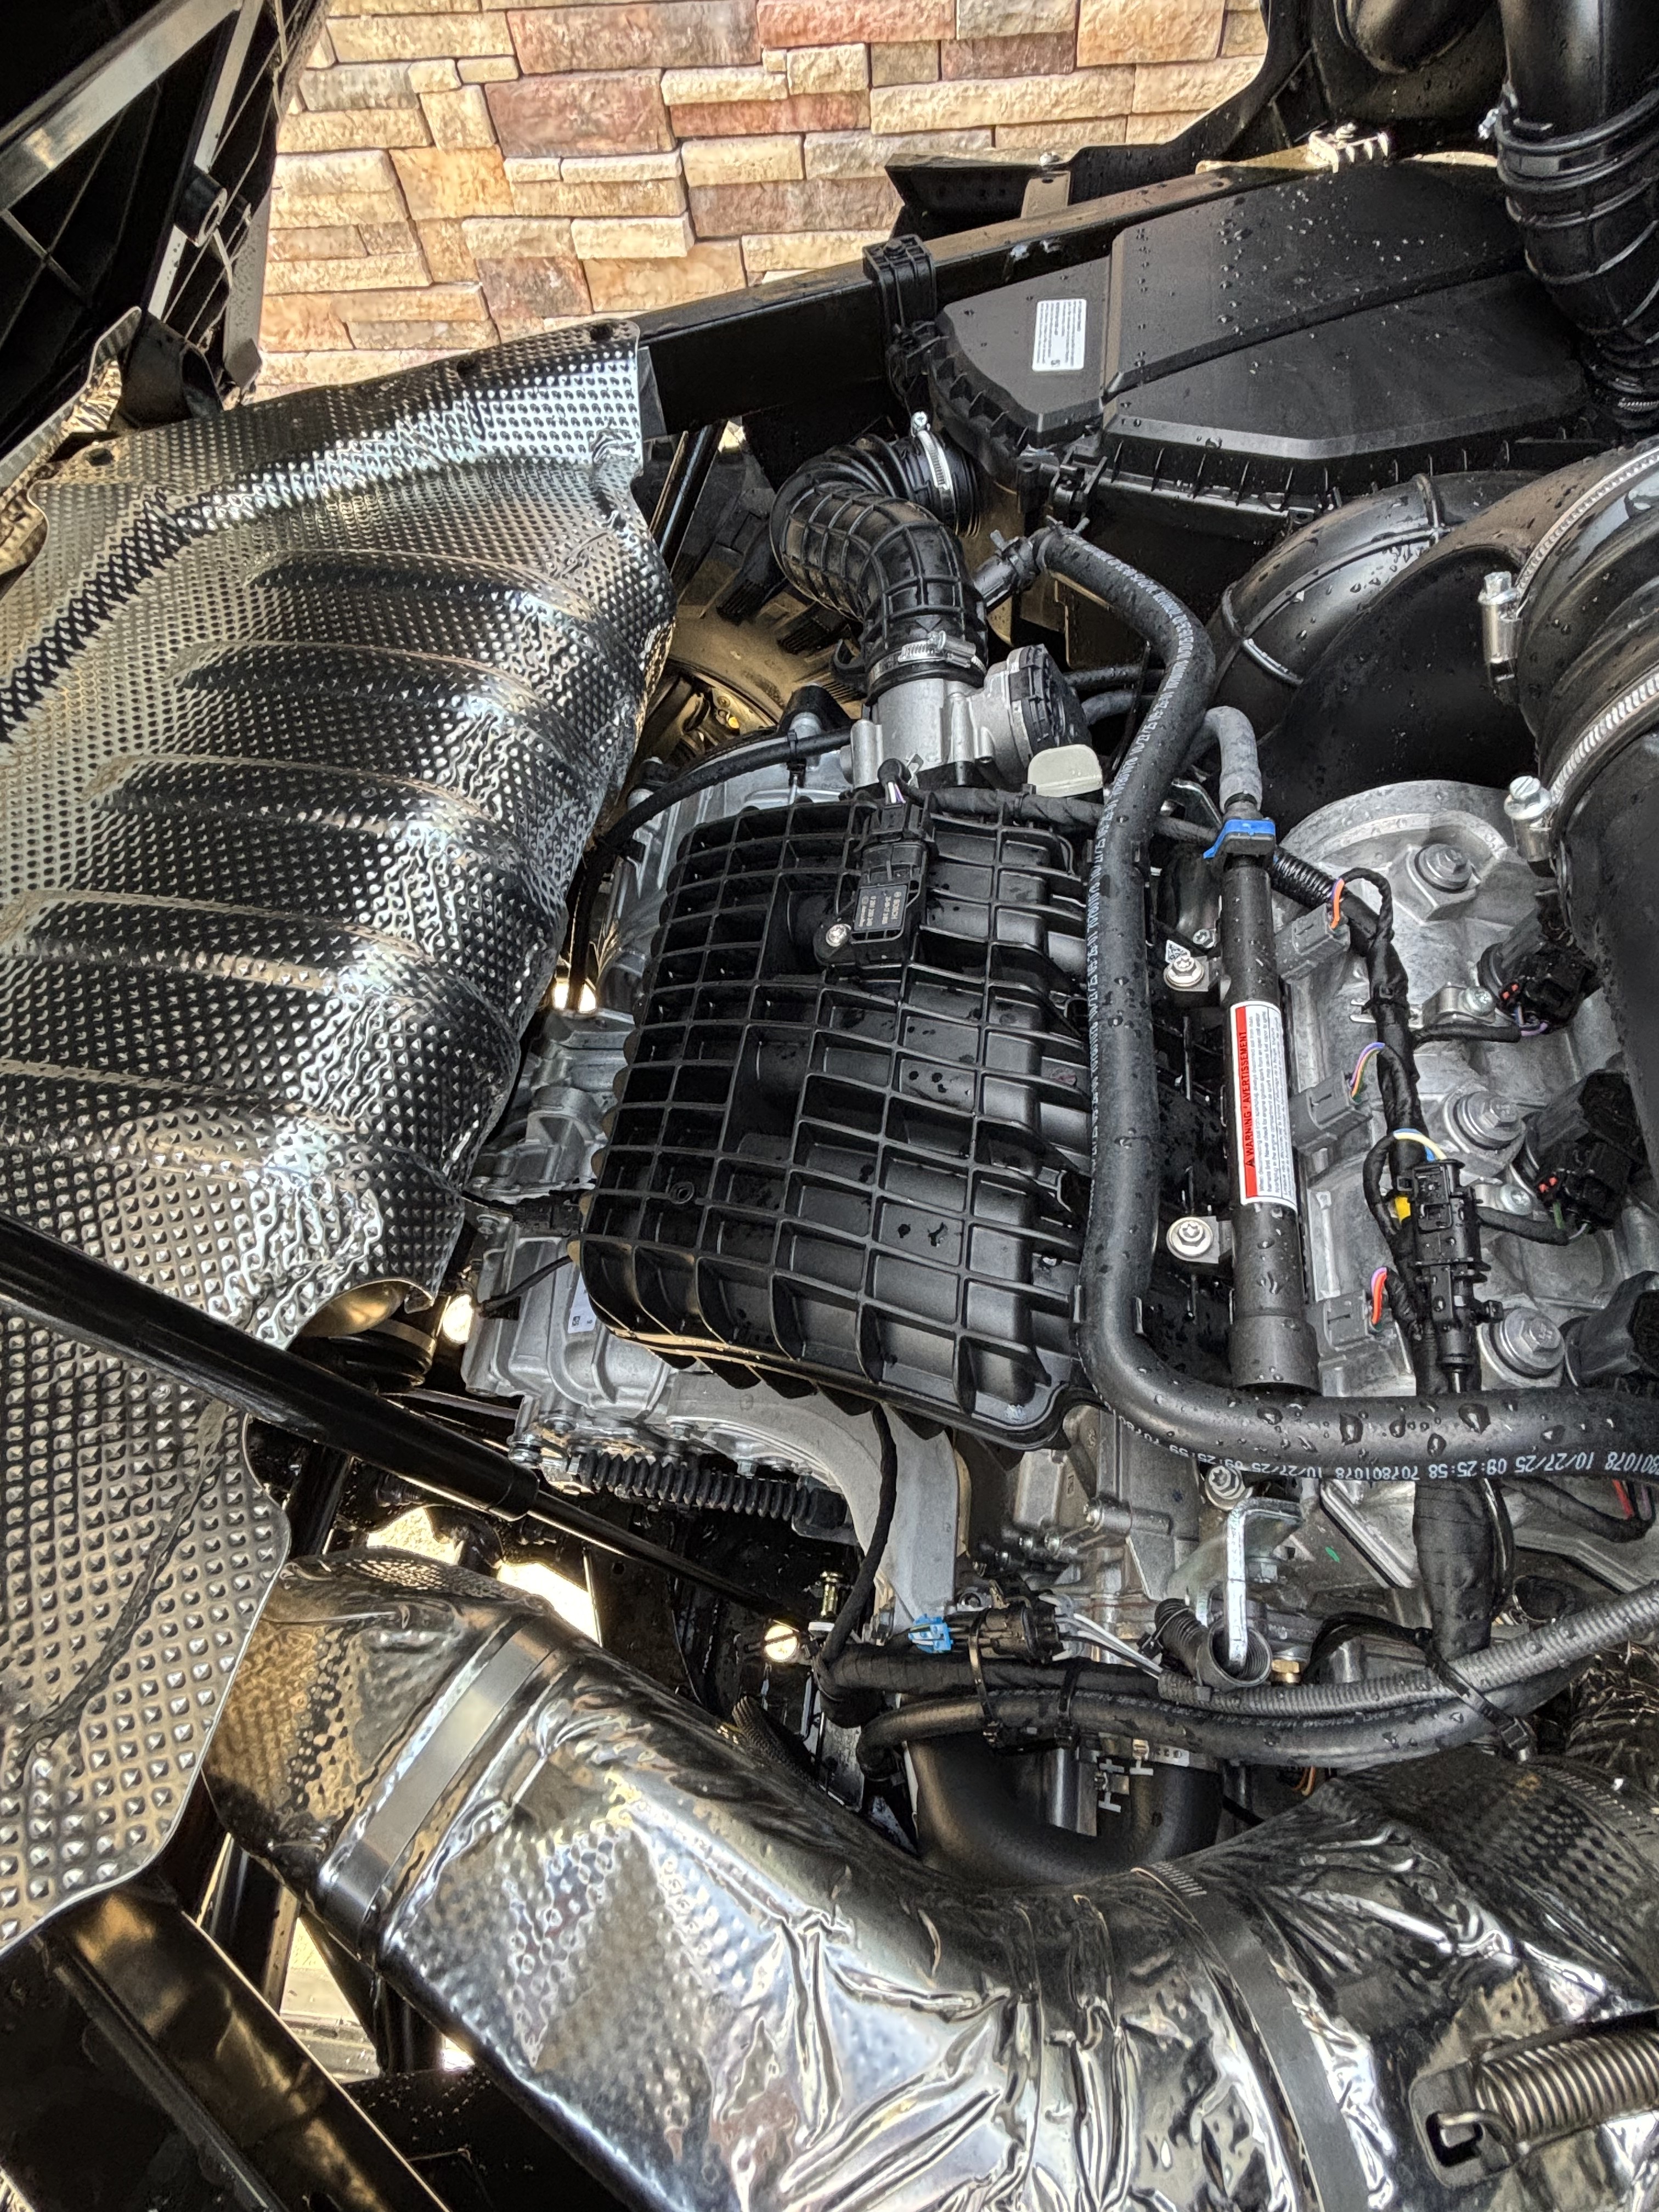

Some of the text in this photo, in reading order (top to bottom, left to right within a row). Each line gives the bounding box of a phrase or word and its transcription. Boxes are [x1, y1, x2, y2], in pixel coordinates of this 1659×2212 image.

[1239, 1031, 1250, 1103] AVERTISSEMENT
[1243, 1111, 1253, 1155] WARNING
[1335, 1465, 1420, 1481] 707801078
[1514, 1451, 1594, 1473] 10/27/25
